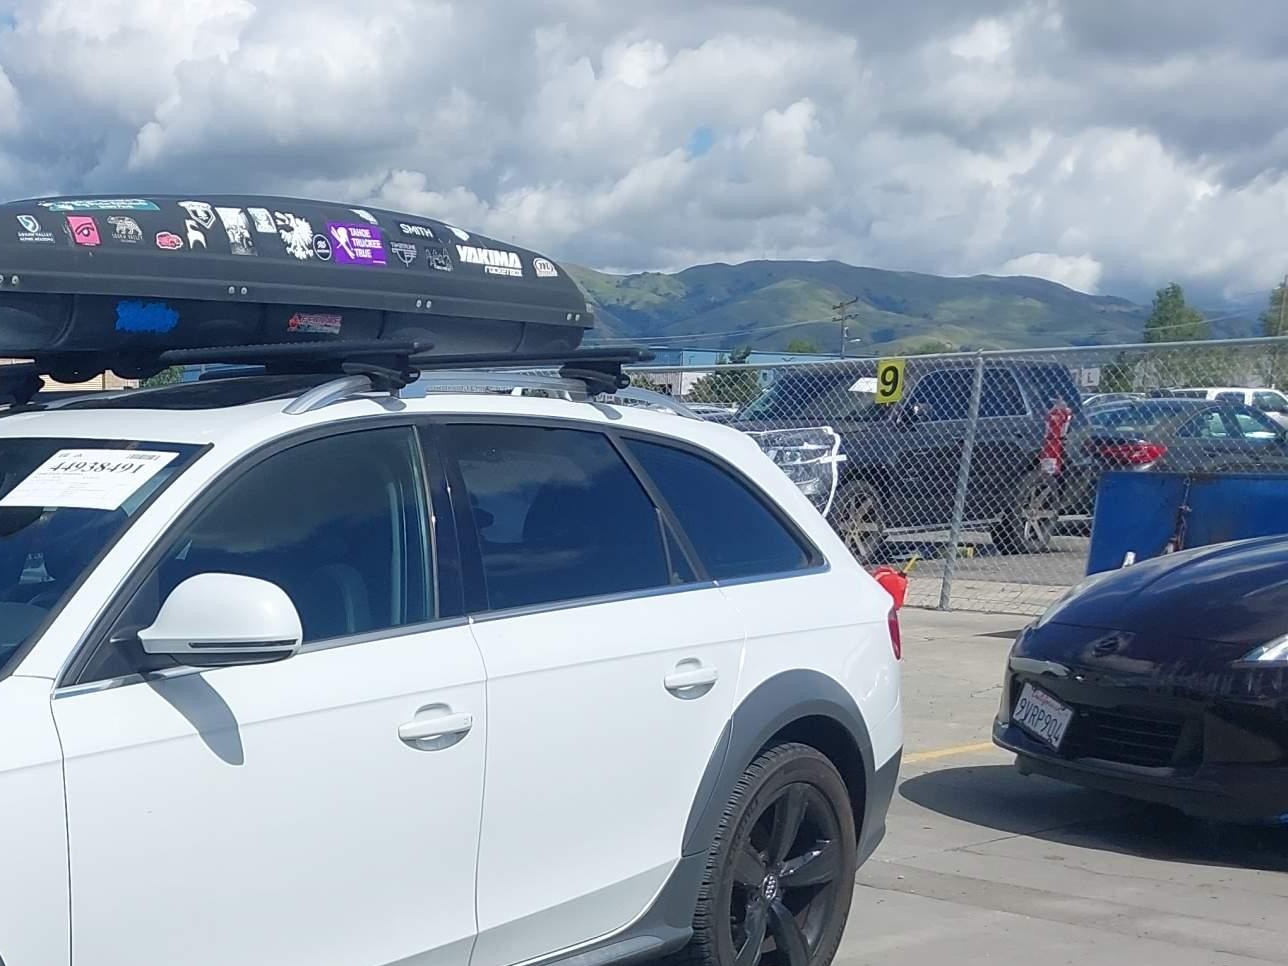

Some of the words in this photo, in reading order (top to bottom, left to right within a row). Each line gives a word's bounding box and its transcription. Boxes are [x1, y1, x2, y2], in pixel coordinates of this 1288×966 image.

[348, 227, 372, 238] TAHOE
[400, 223, 434, 239] SMITH
[351, 237, 383, 249] TRUCKEE
[353, 248, 373, 258] TRUE
[455, 244, 523, 269] YAKIMA
[880, 365, 899, 397] 9
[49, 461, 145, 474] 44938491
